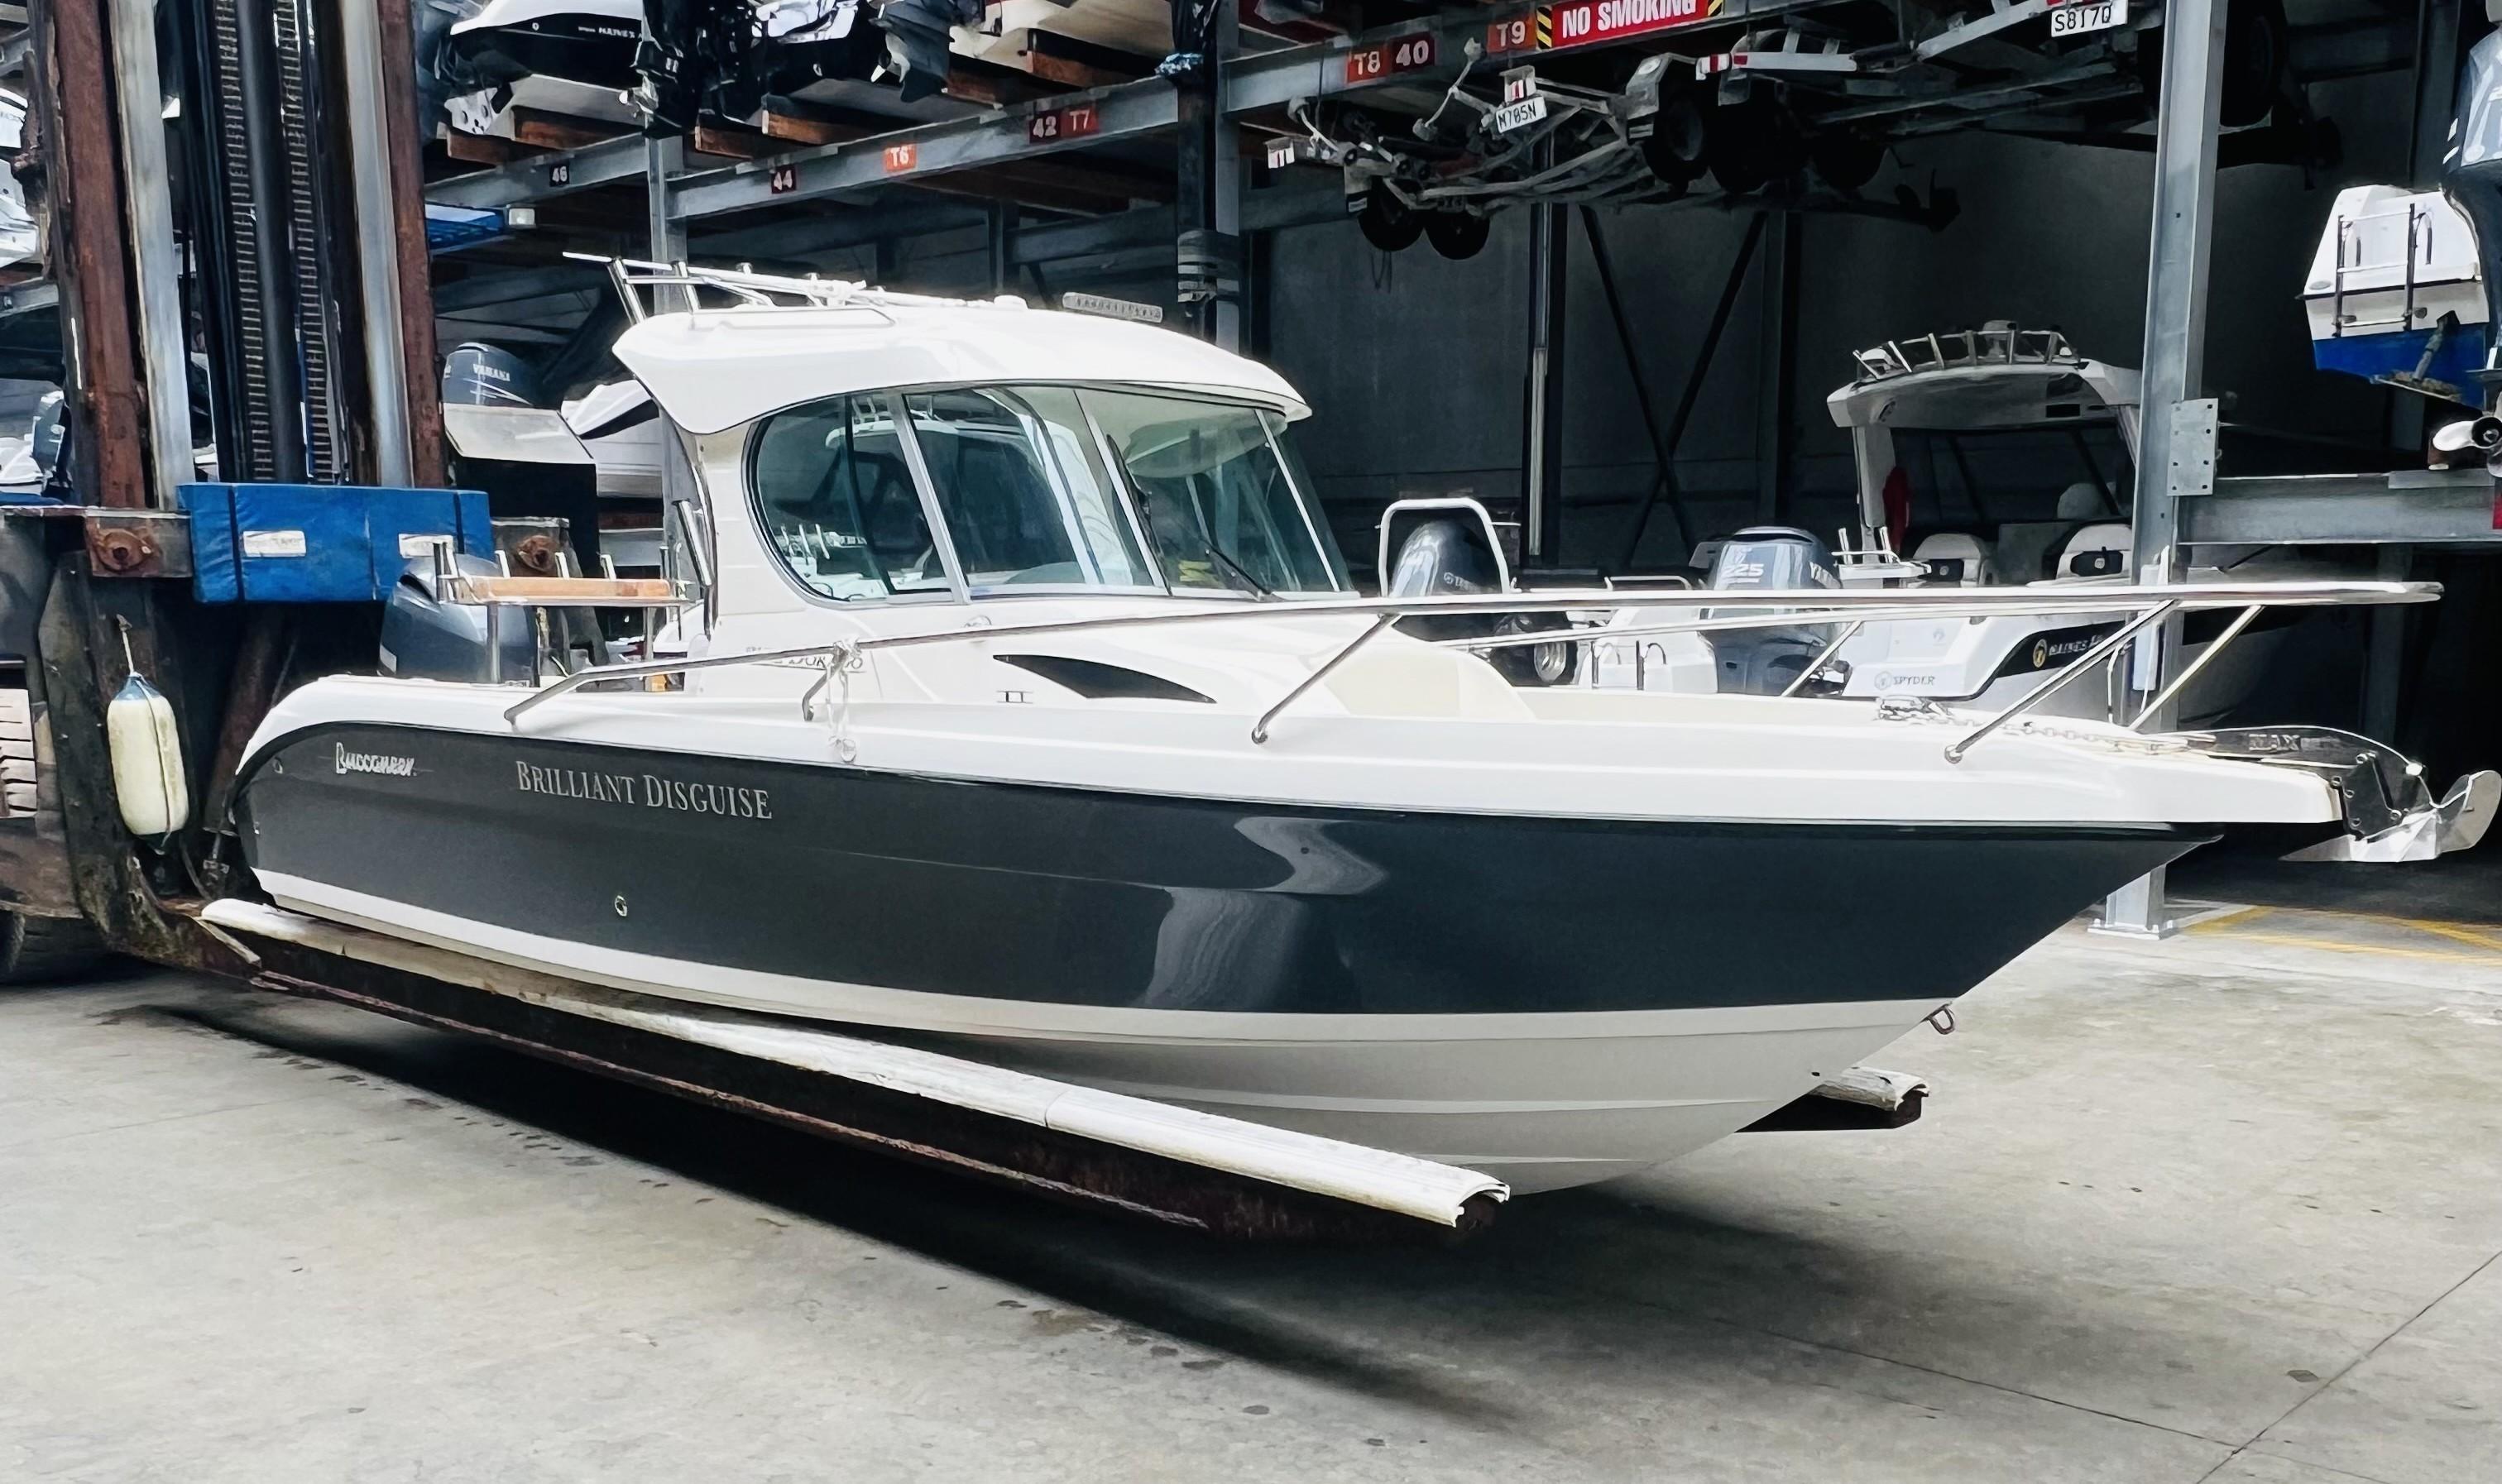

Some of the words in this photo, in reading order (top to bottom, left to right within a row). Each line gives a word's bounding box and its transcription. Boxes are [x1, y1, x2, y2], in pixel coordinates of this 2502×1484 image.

[1496, 21, 1526, 46] T9
[1562, 7, 1590, 38] NO
[1354, 51, 1381, 75] T8
[1396, 40, 1429, 66] 40
[1033, 115, 1057, 138] 42
[1069, 108, 1090, 132] T7
[773, 170, 793, 191] 44
[515, 760, 636, 805] BRILLIANT
[643, 774, 772, 820] DISGUISE
